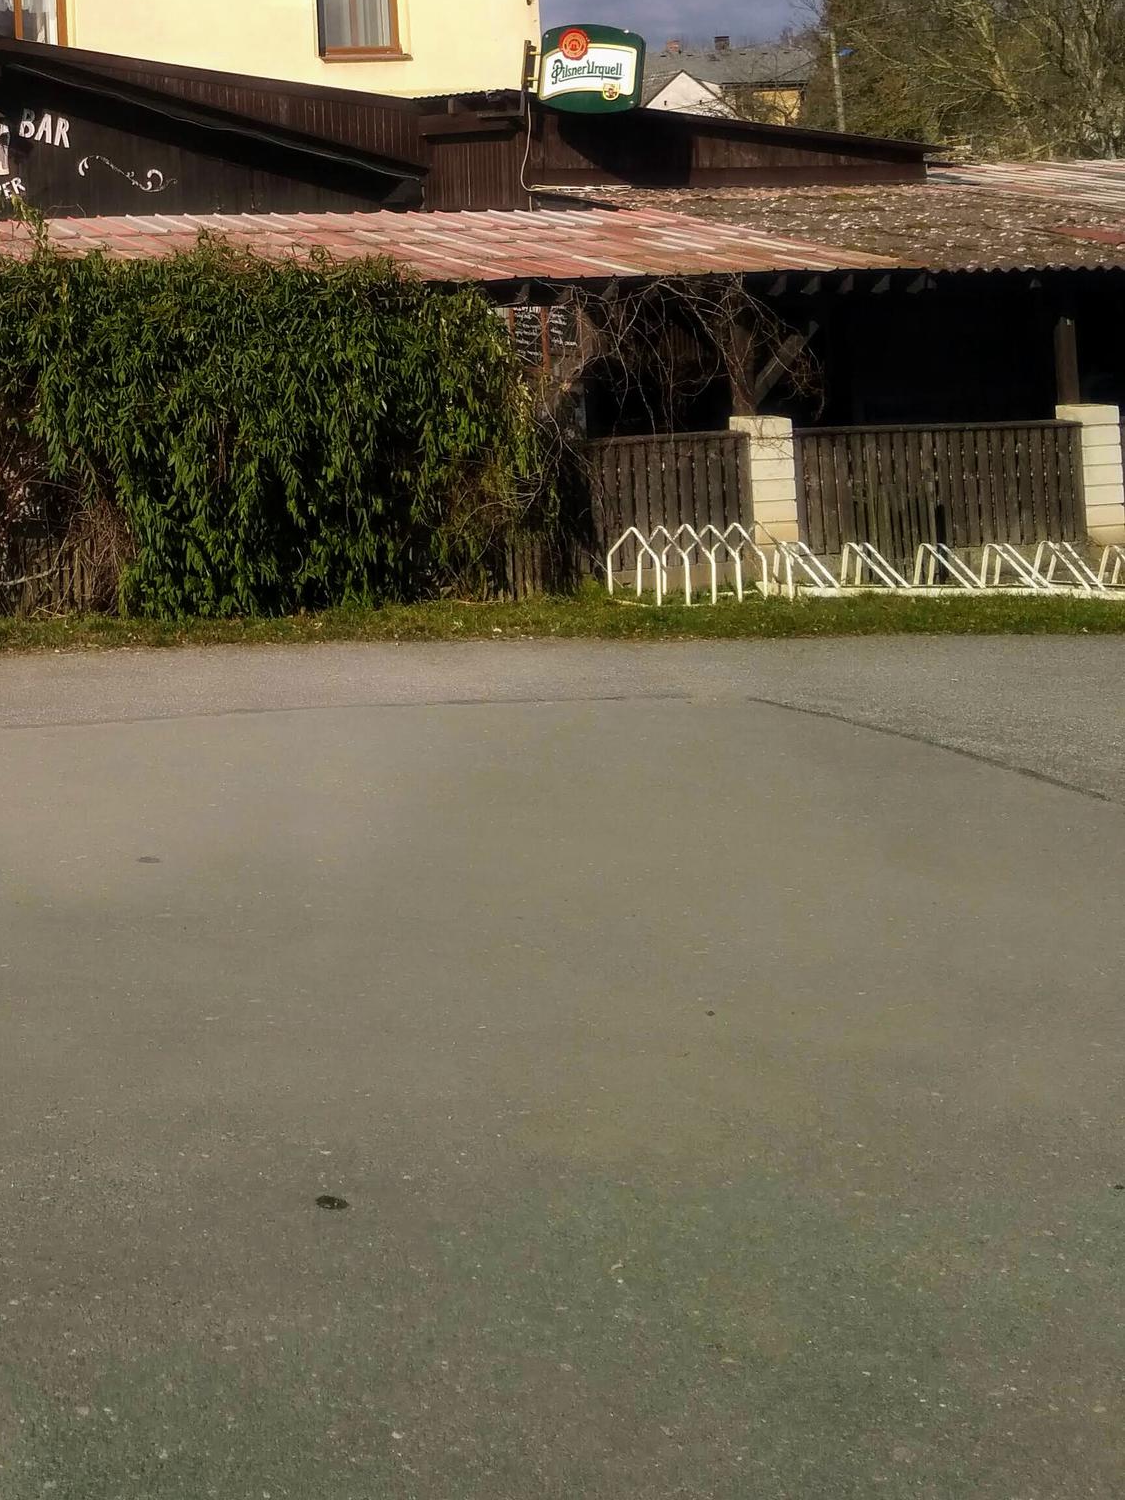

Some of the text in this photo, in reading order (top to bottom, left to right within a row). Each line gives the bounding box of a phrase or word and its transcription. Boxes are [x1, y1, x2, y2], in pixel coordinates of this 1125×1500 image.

[551, 59, 623, 85] Pilsner Urquell
[19, 108, 70, 149] BAR
